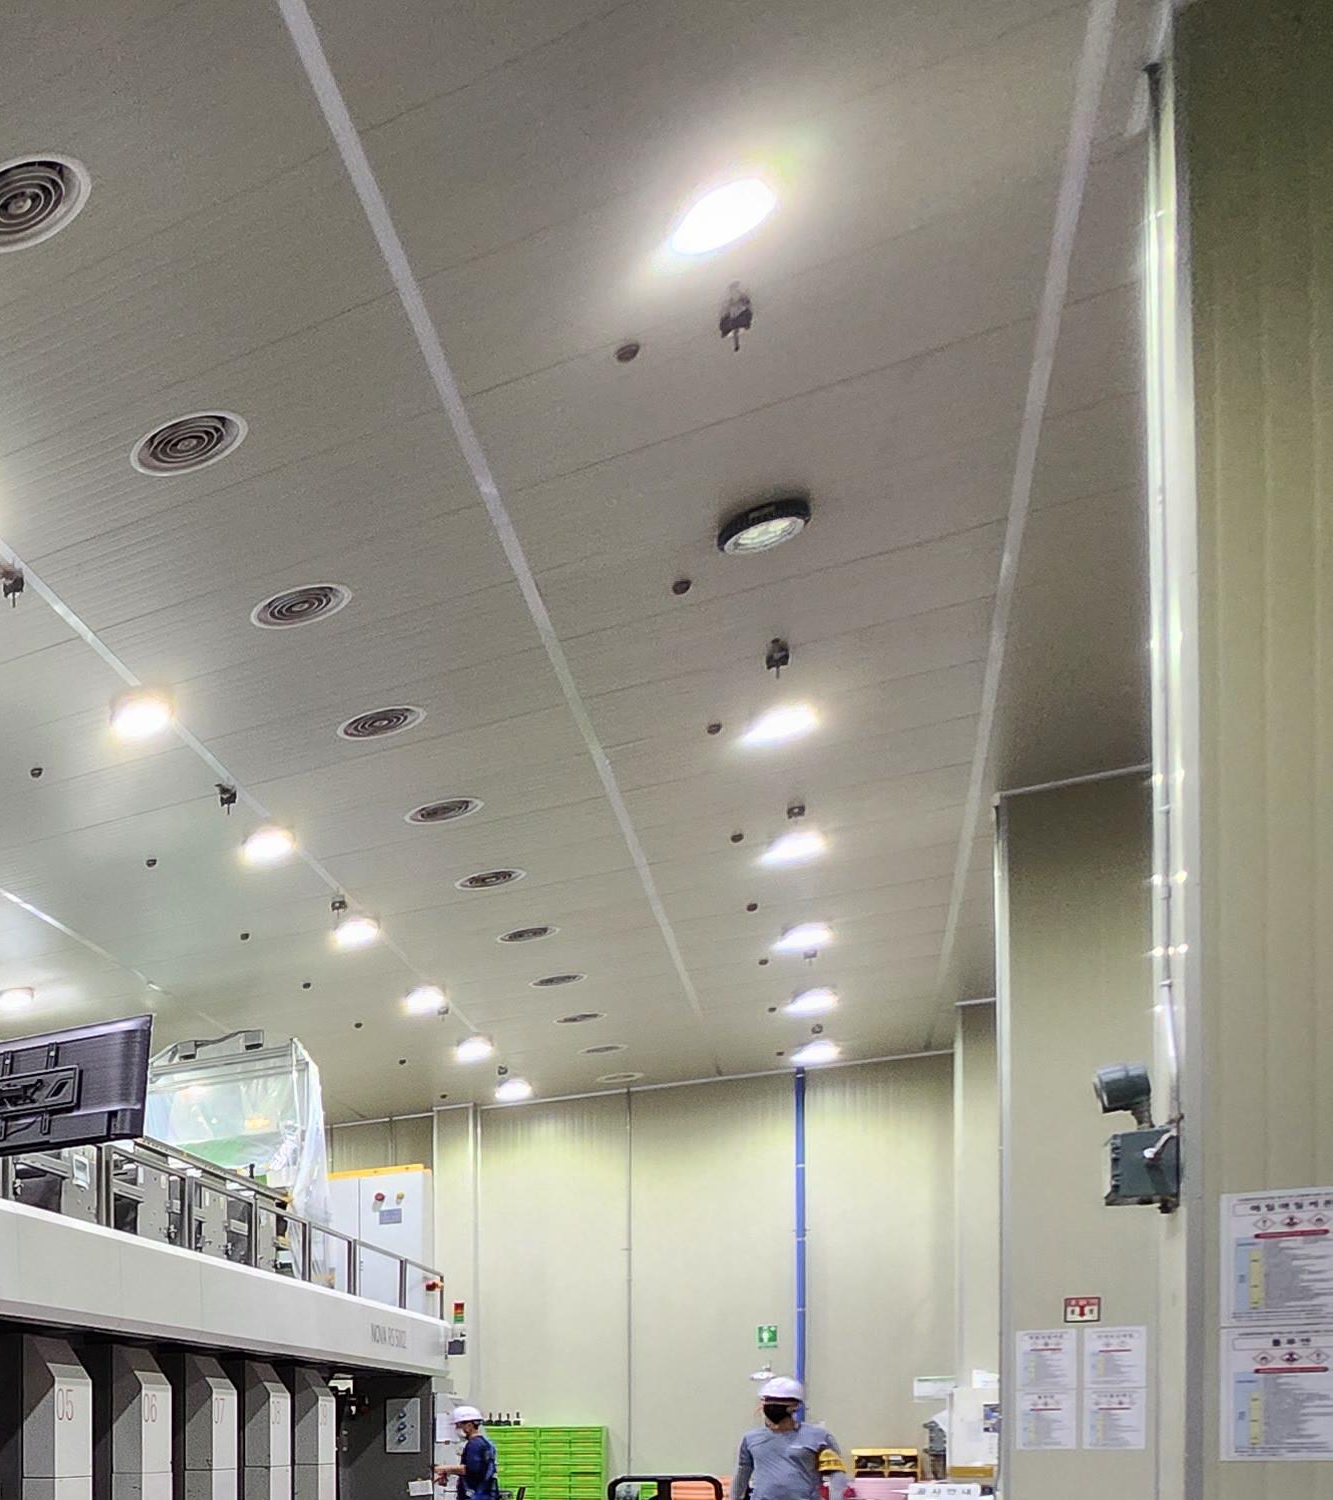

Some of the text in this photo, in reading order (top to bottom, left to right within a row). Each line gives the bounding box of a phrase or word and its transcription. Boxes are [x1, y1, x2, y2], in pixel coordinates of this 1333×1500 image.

[55, 1388, 74, 1421] 05
[141, 1393, 158, 1423] 06
[213, 1397, 226, 1424] 07
